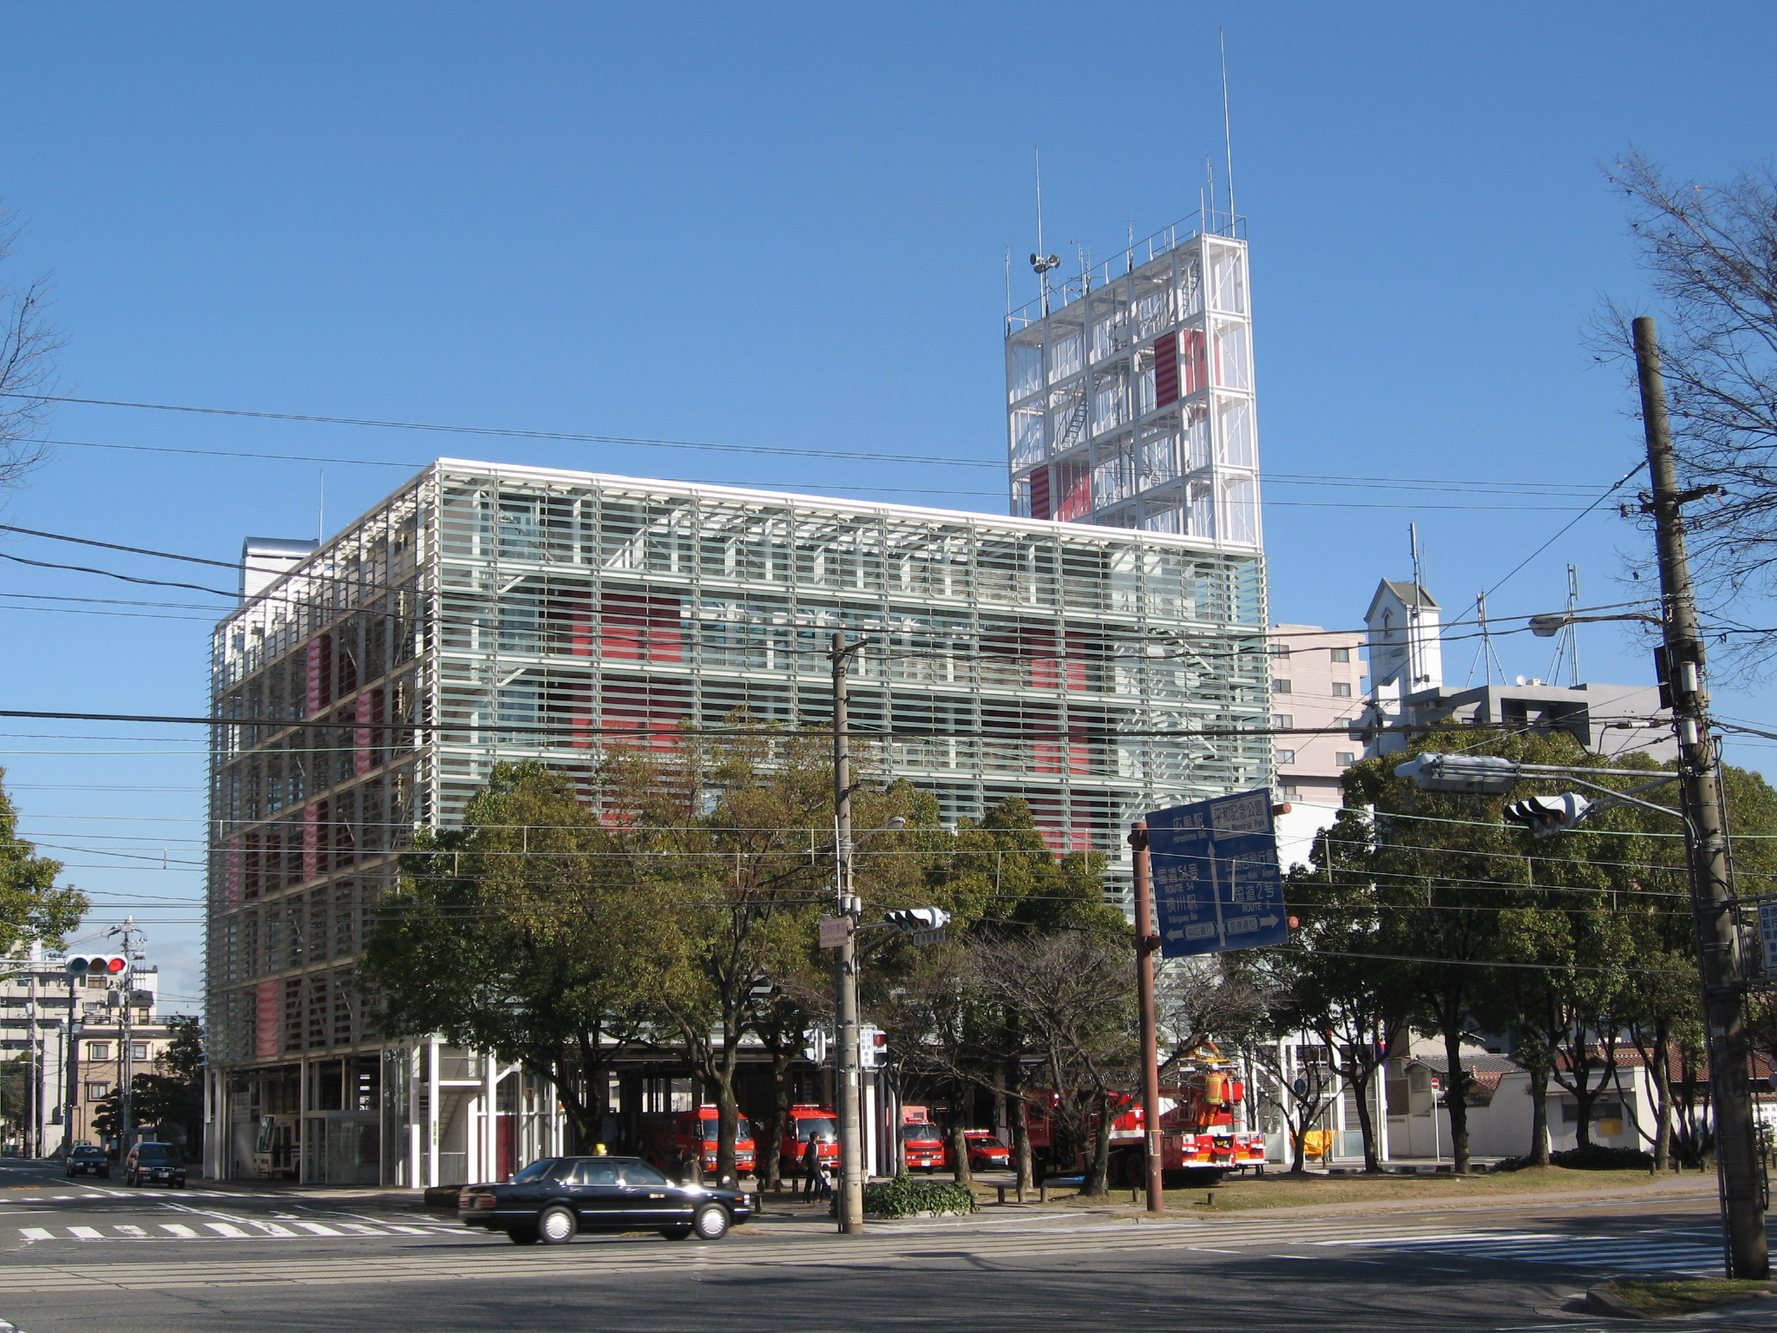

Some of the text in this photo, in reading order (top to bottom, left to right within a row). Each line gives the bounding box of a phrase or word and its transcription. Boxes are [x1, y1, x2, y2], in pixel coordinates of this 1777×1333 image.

[1173, 812, 1205, 833] 広島駅
[1164, 884, 1184, 894] ROUTE
[1242, 902, 1262, 913] ROUTE
